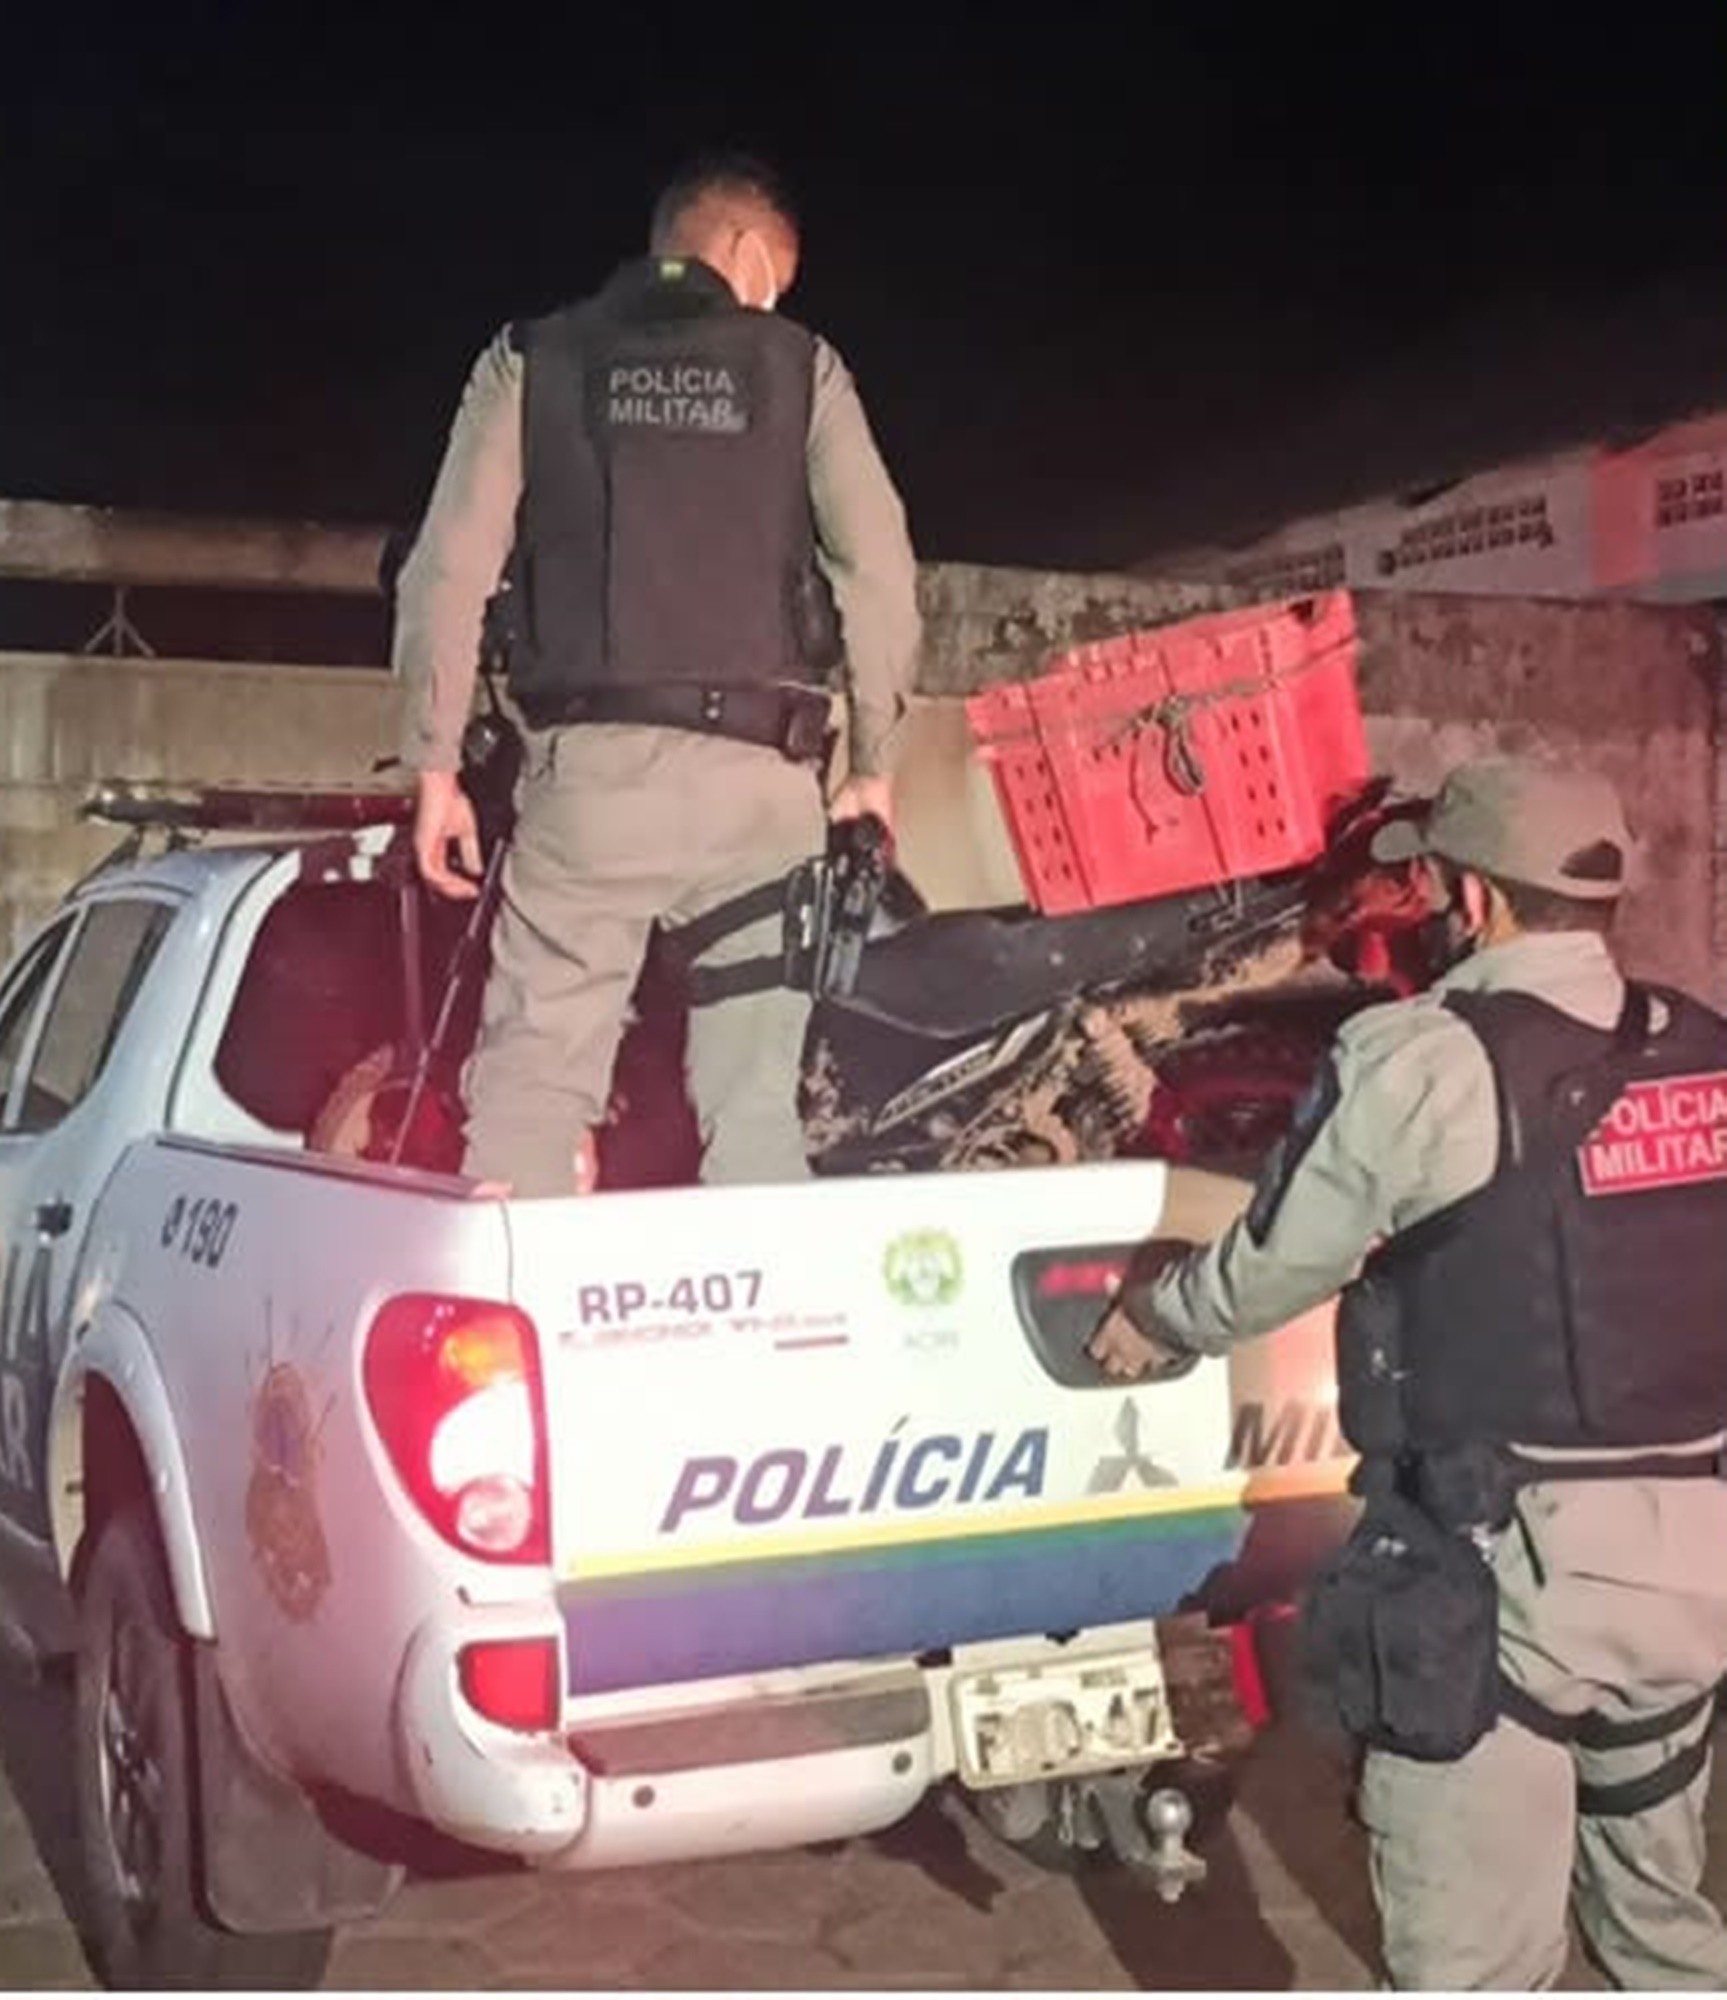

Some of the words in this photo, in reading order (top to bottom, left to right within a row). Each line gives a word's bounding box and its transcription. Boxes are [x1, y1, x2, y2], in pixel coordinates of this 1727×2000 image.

[608, 397, 738, 426] MILITAR
[180, 1198, 239, 1268] 190
[577, 1269, 764, 1326] RP-407
[658, 1415, 1050, 1533] POLÍCIA
